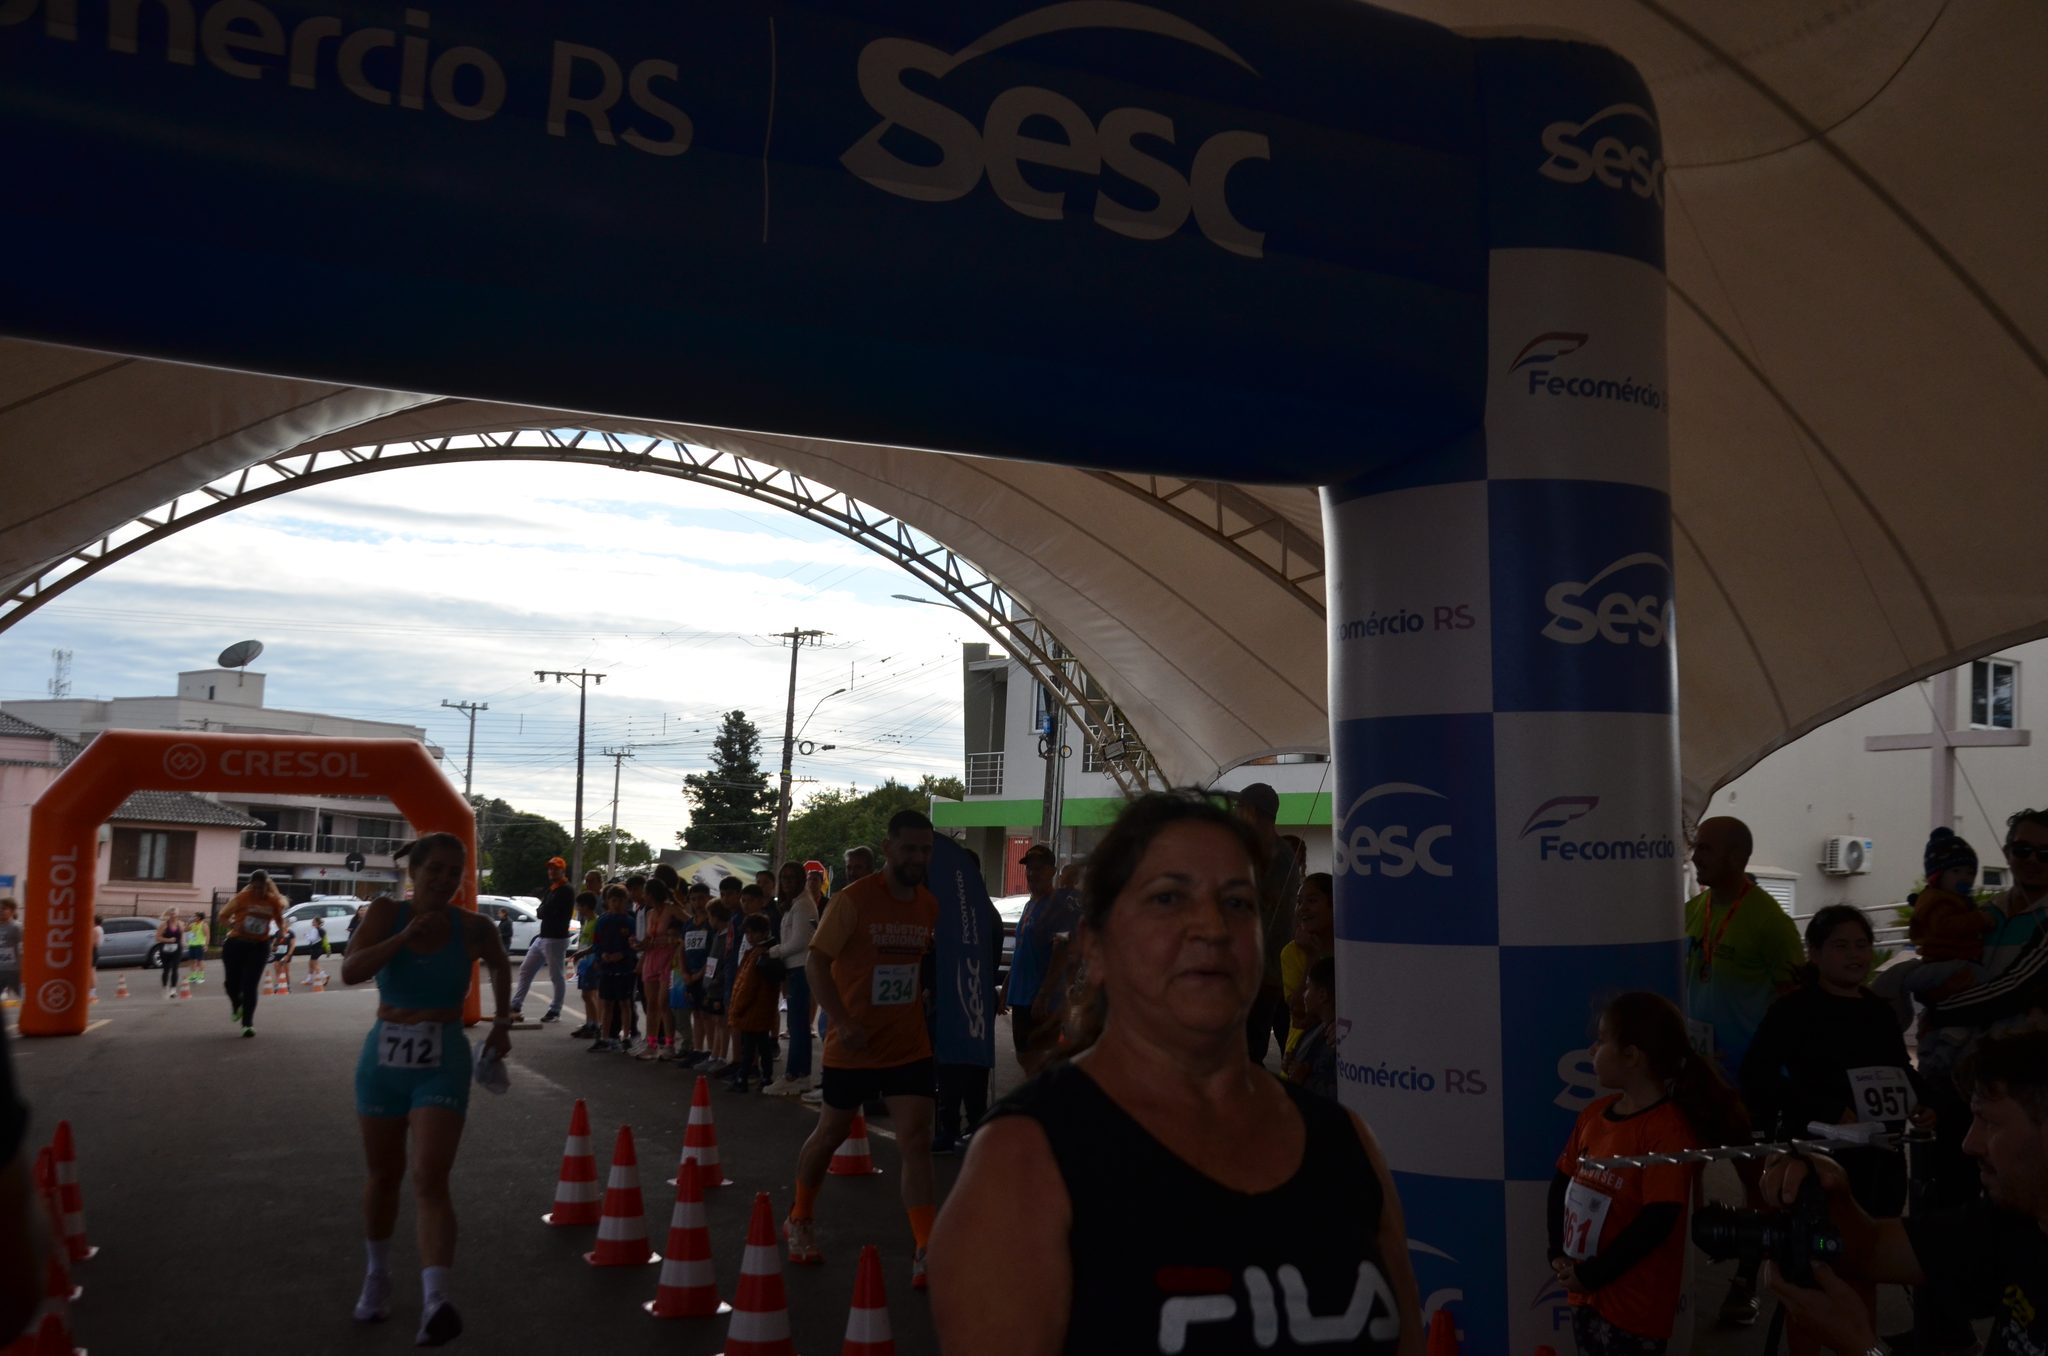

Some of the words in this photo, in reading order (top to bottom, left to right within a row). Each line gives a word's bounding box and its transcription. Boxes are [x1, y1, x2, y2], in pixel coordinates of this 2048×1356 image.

[546, 40, 695, 157] RS
[840, 0, 1272, 258] Sesc
[1529, 370, 1660, 409] Fecomércio
[1433, 604, 1475, 631] RS
[218, 749, 369, 779] CRESOL
[1540, 834, 1675, 861] Fecomércio
[45, 846, 78, 969] CRESOL
[878, 978, 913, 1001] 234
[957, 957, 985, 1040] Sesc
[387, 1036, 433, 1064] 712
[1337, 1056, 1435, 1092] ecomércio
[1445, 1068, 1488, 1096] RS
[1864, 1087, 1908, 1117] 957
[1154, 1258, 1401, 1356] FILA
